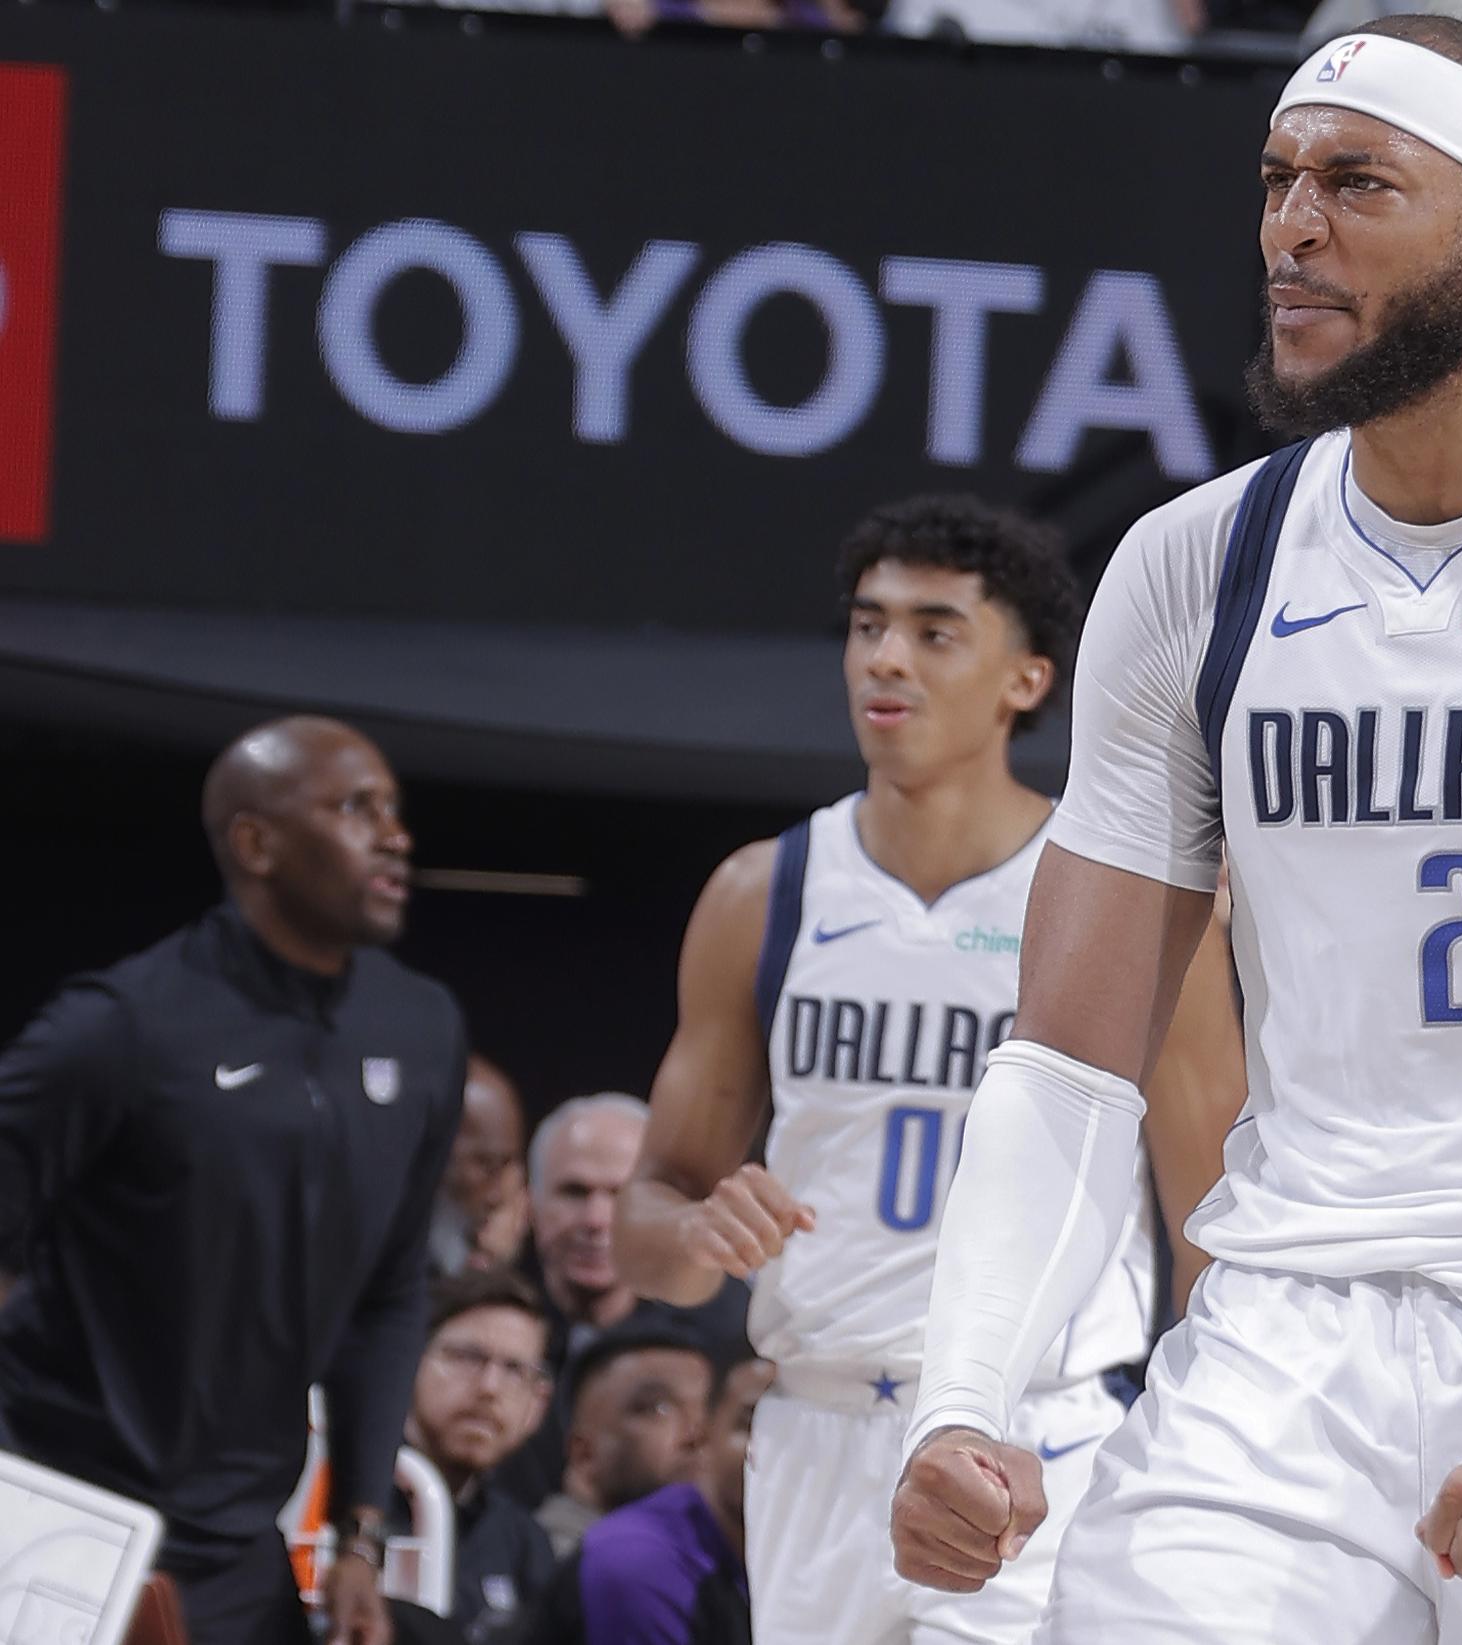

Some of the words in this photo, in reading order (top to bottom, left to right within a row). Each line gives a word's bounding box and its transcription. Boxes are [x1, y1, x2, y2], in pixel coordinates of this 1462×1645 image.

[158, 207, 1217, 482] TOYOTA
[955, 925, 1019, 953] chim
[878, 1106, 967, 1233] 0
